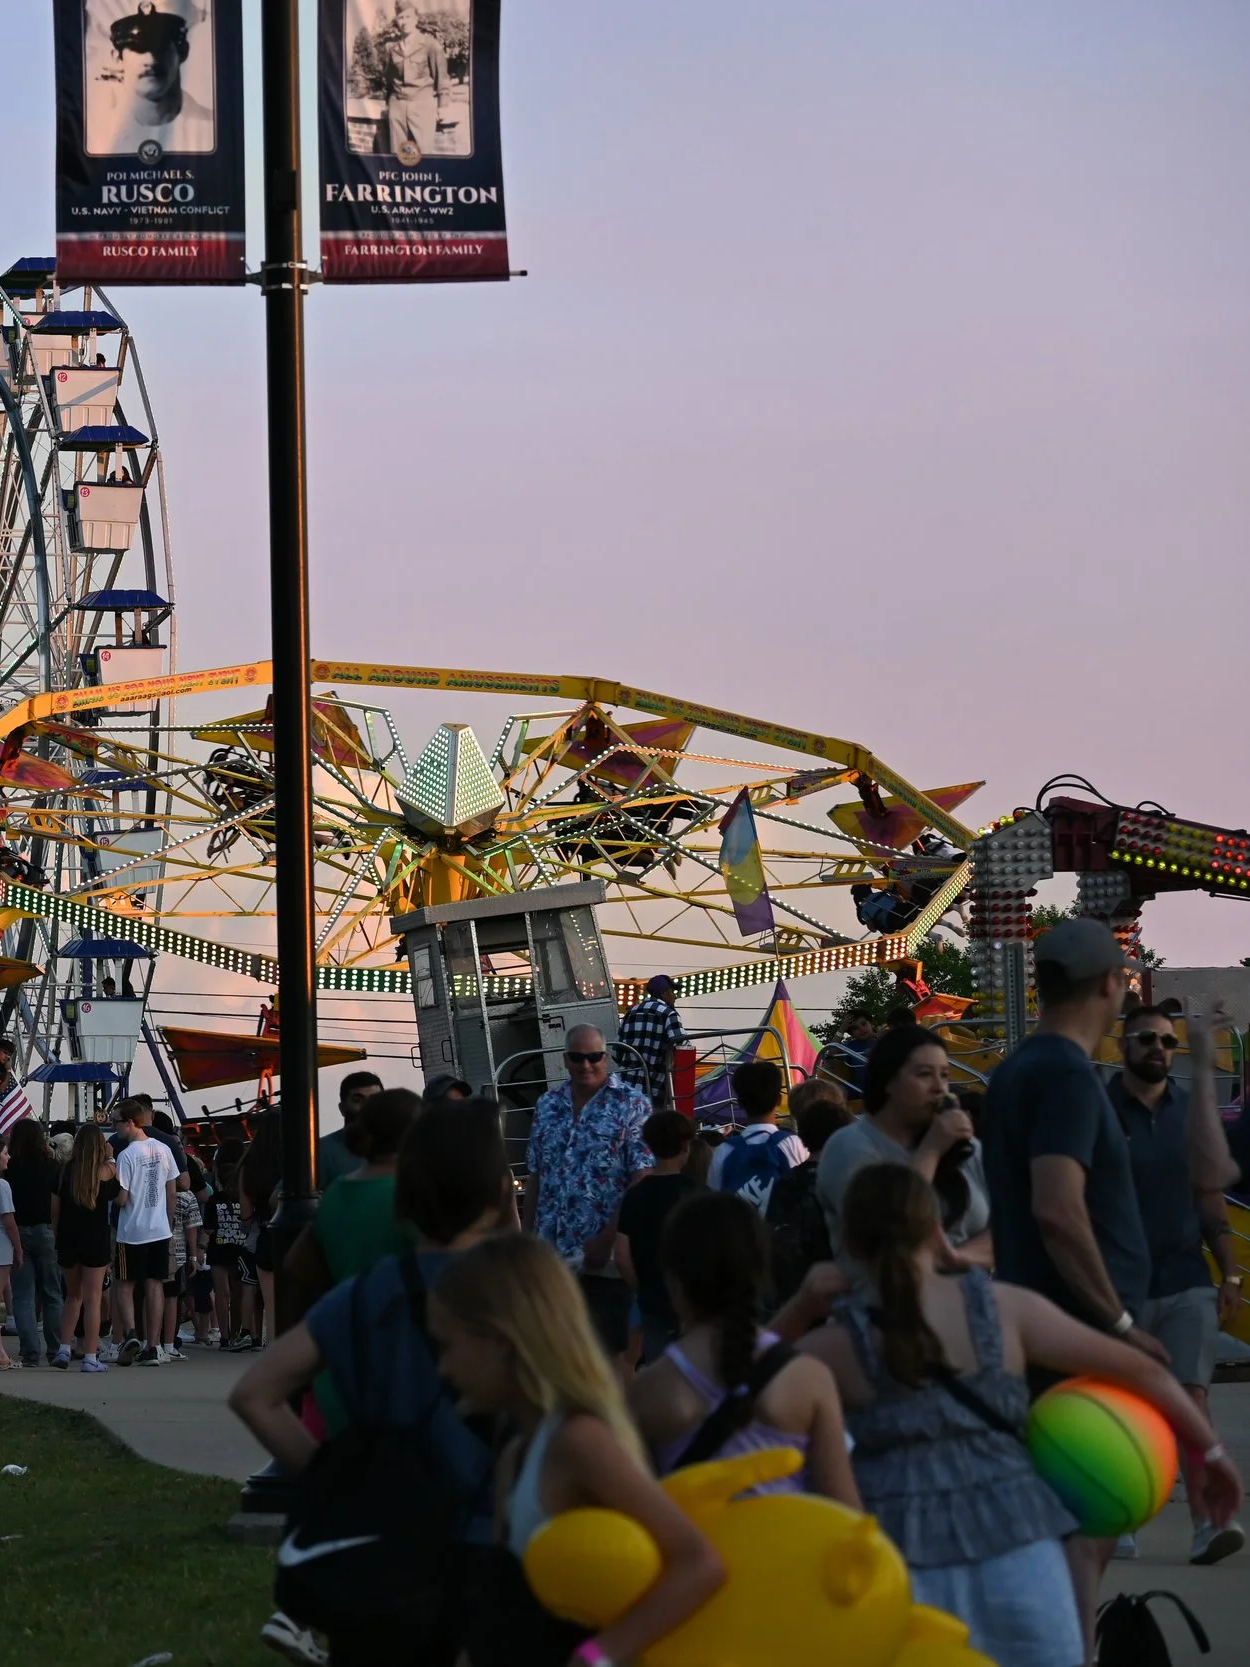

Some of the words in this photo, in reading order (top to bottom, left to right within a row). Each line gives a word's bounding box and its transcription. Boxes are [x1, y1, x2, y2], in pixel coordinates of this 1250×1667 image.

[130, 170, 183, 181] MICHAEL
[185, 170, 195, 179] S.
[379, 171, 399, 181] PFC
[402, 172, 432, 182] JOHN
[435, 173, 442, 183] J.
[102, 183, 195, 204] RUSCO
[325, 183, 497, 204] FARRINGTON
[71, 207, 91, 215] U.S.
[93, 207, 121, 215] NAVY
[130, 206, 178, 215] VIETNAM
[180, 206, 230, 215] CONFLICT
[371, 205, 390, 214] U.S.
[392, 206, 420, 215] ARMY
[429, 207, 454, 215] WW2
[103, 246, 148, 257] RUSCO
[152, 246, 199, 257] FAMILY
[345, 244, 432, 256] FARRINGTON
[436, 244, 483, 256] FAMILY
[332, 666, 363, 681] ALL
[368, 668, 440, 685] AROUND
[446, 672, 560, 693] AMUSEMENTS
